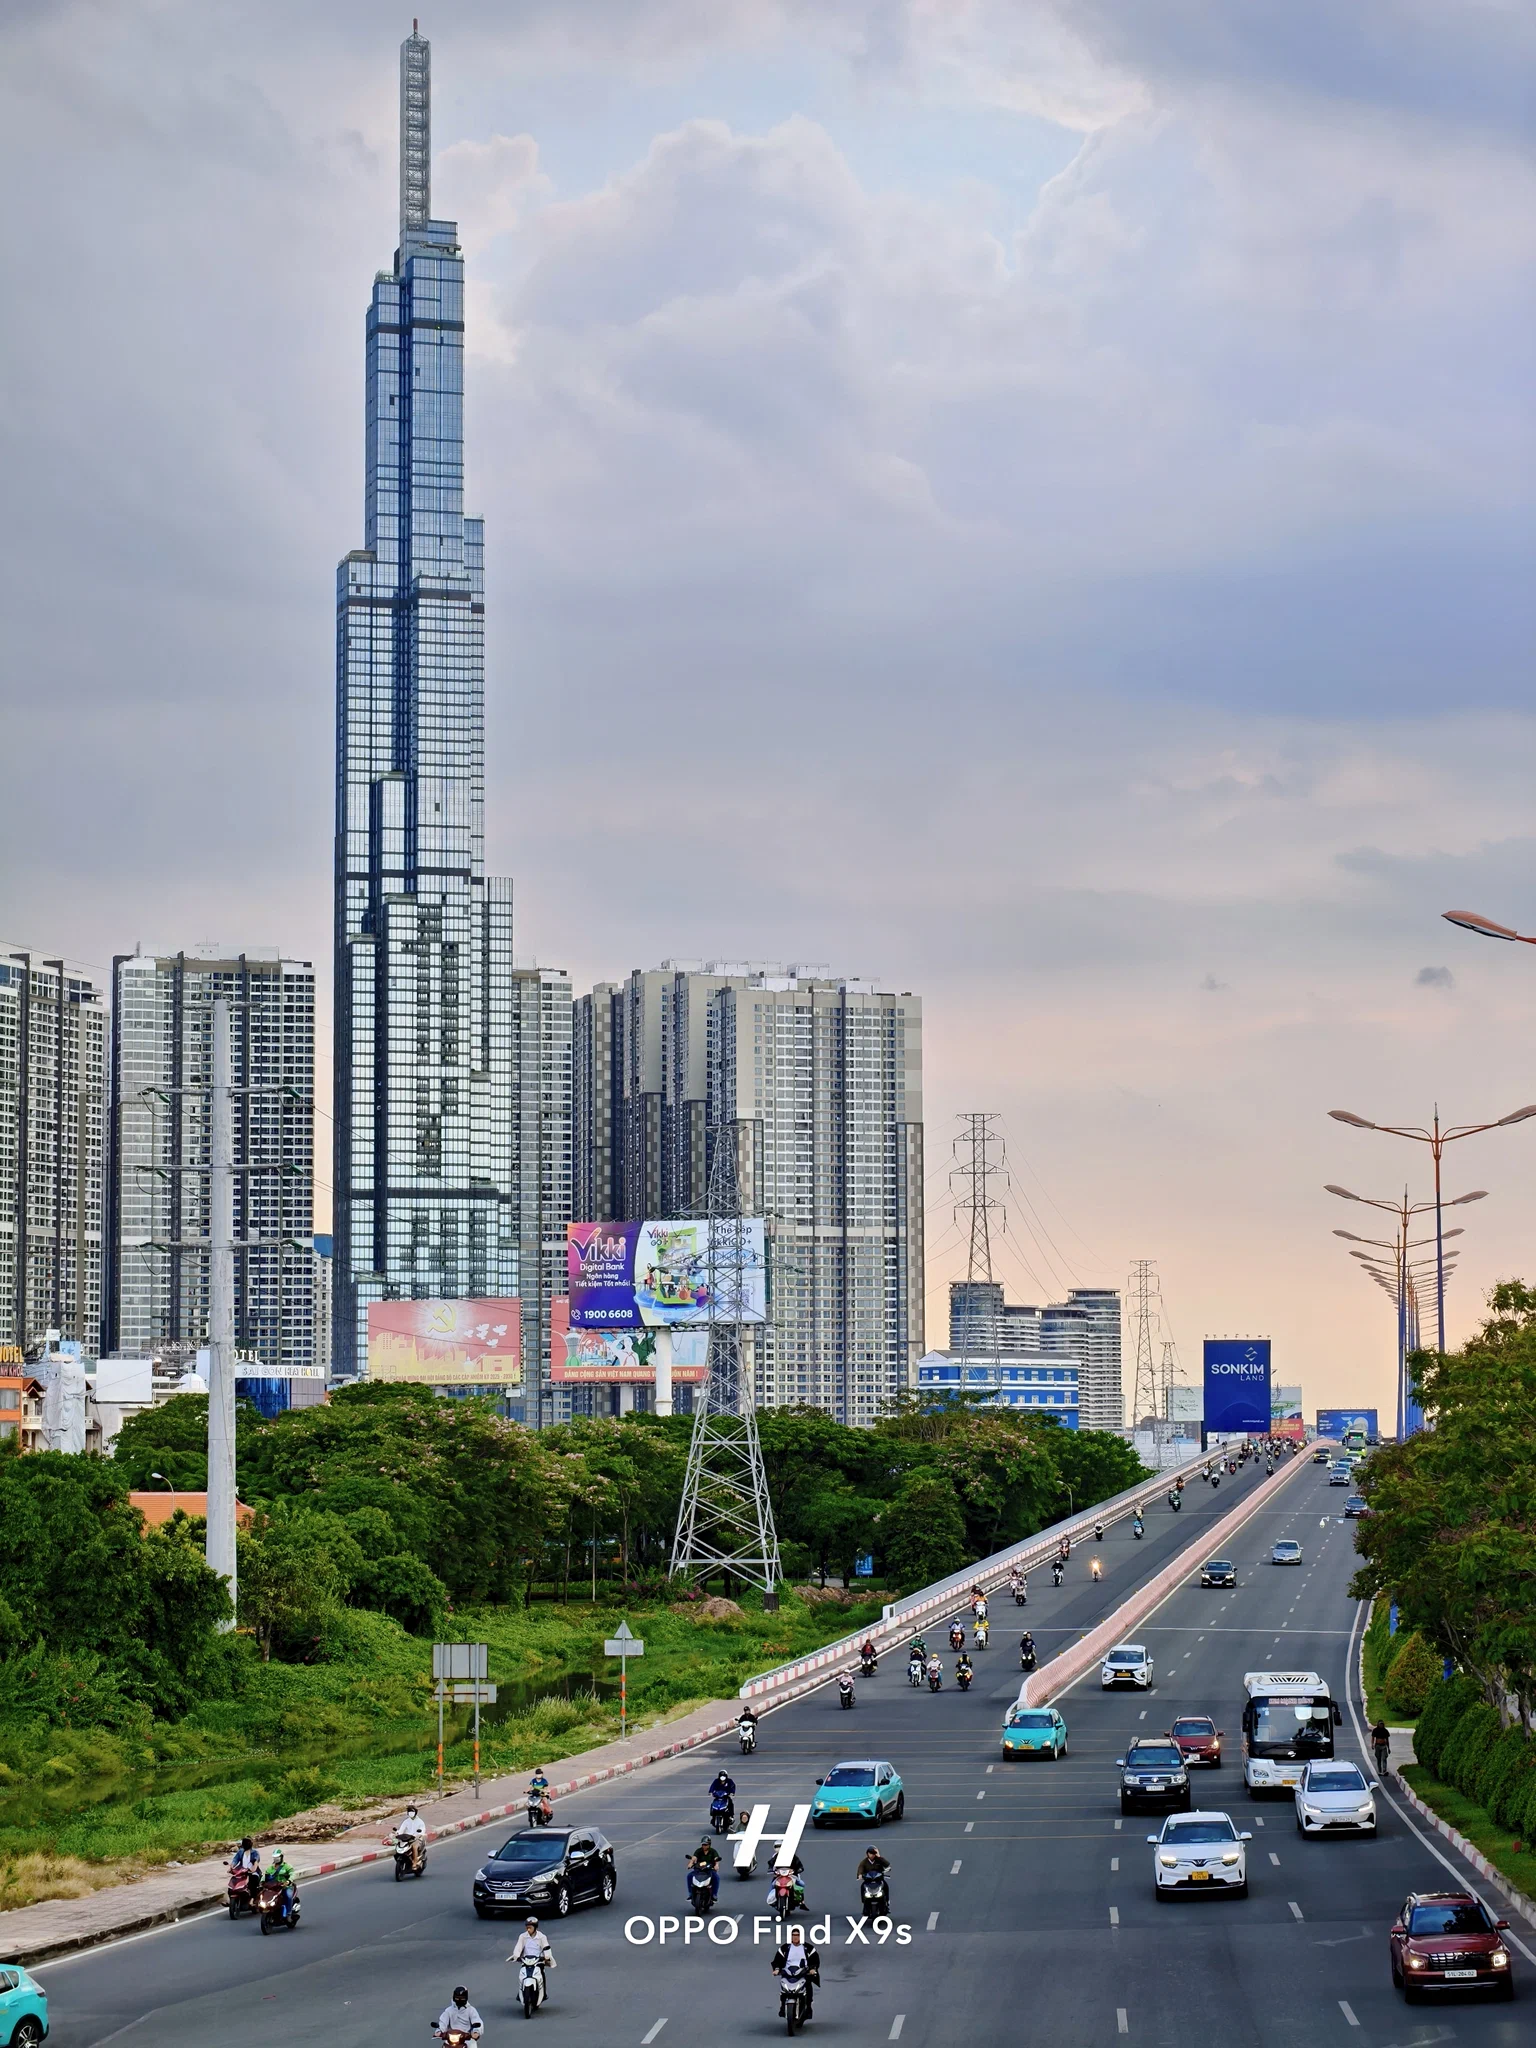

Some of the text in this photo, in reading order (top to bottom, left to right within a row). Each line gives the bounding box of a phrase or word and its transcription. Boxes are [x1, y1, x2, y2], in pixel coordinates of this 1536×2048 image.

[647, 1225, 669, 1239] Vikki
[570, 1227, 627, 1262] Vikki
[580, 1263, 625, 1273] Digital Bank
[588, 1280, 603, 1288] kiệm
[603, 1279, 614, 1287] Tốt
[584, 1310, 633, 1318] 1900 6608
[262, 1367, 282, 1376] GON
[564, 1370, 579, 1378] ĐẢNG
[580, 1370, 595, 1379] CỘNG
[595, 1369, 607, 1378] SẢN
[607, 1370, 618, 1379] VIỆT
[1211, 1364, 1265, 1374] SONKIM
